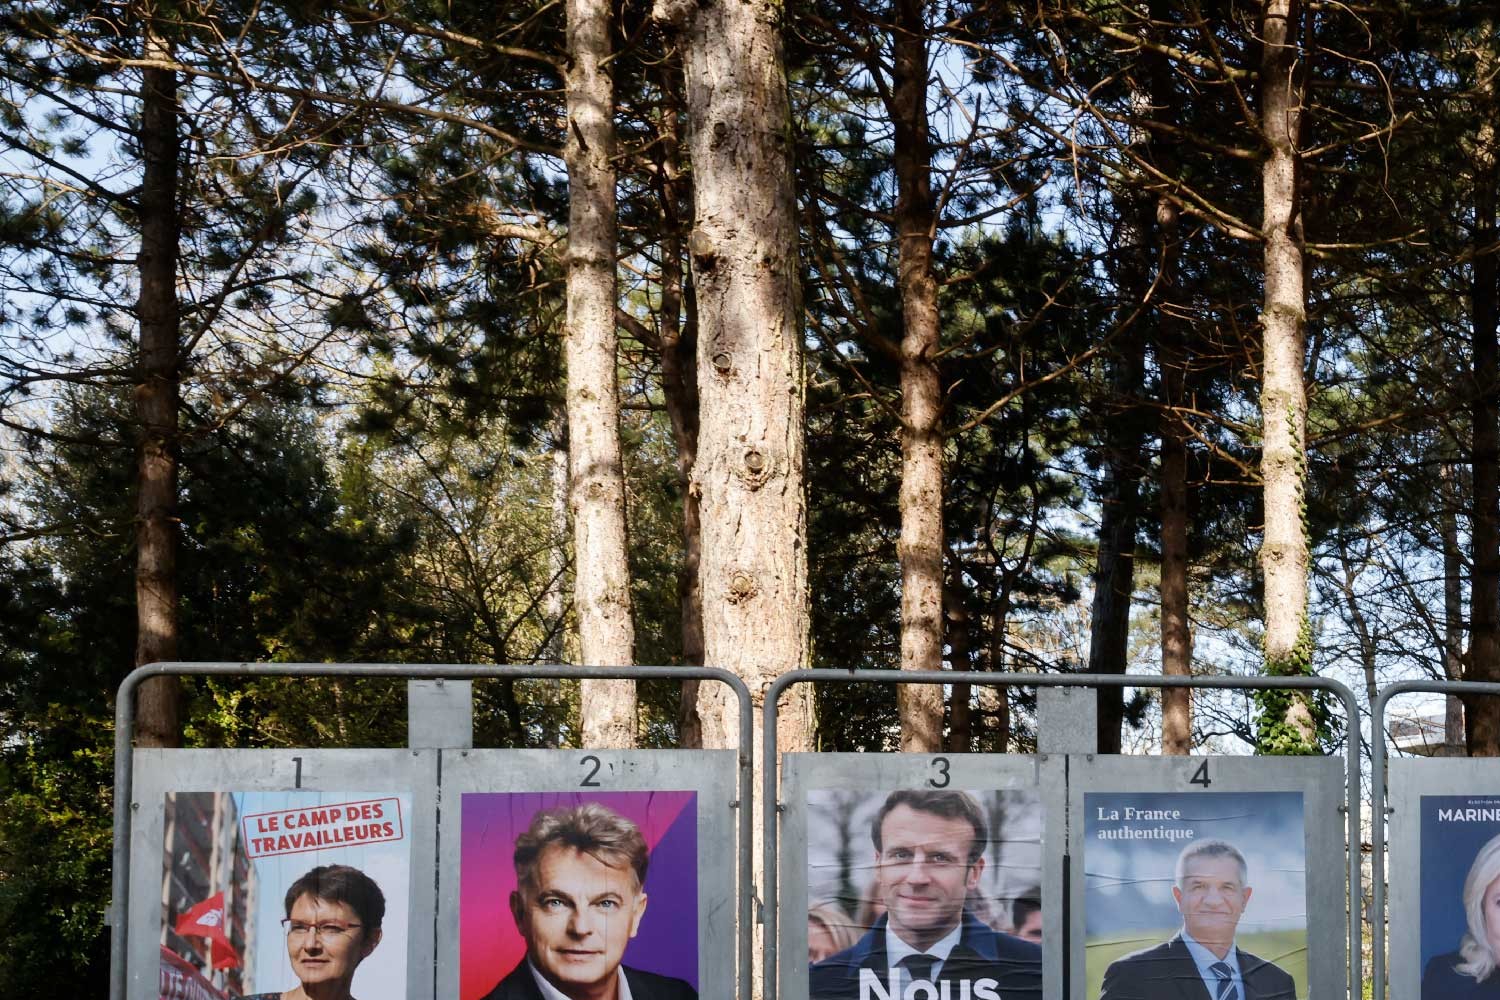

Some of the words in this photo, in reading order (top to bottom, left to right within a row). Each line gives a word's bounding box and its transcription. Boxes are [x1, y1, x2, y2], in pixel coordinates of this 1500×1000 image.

[291, 757, 302, 788] 1
[580, 755, 601, 786] 2
[930, 757, 950, 788] 3
[1189, 757, 1211, 788] 4
[258, 816, 279, 833] LE
[284, 809, 341, 830] CAMP
[347, 803, 383, 822] DES
[1097, 807, 1119, 820] La
[1124, 807, 1181, 820] France
[251, 821, 394, 854] TRAVAILLEURS
[1097, 826, 1194, 842] authentique
